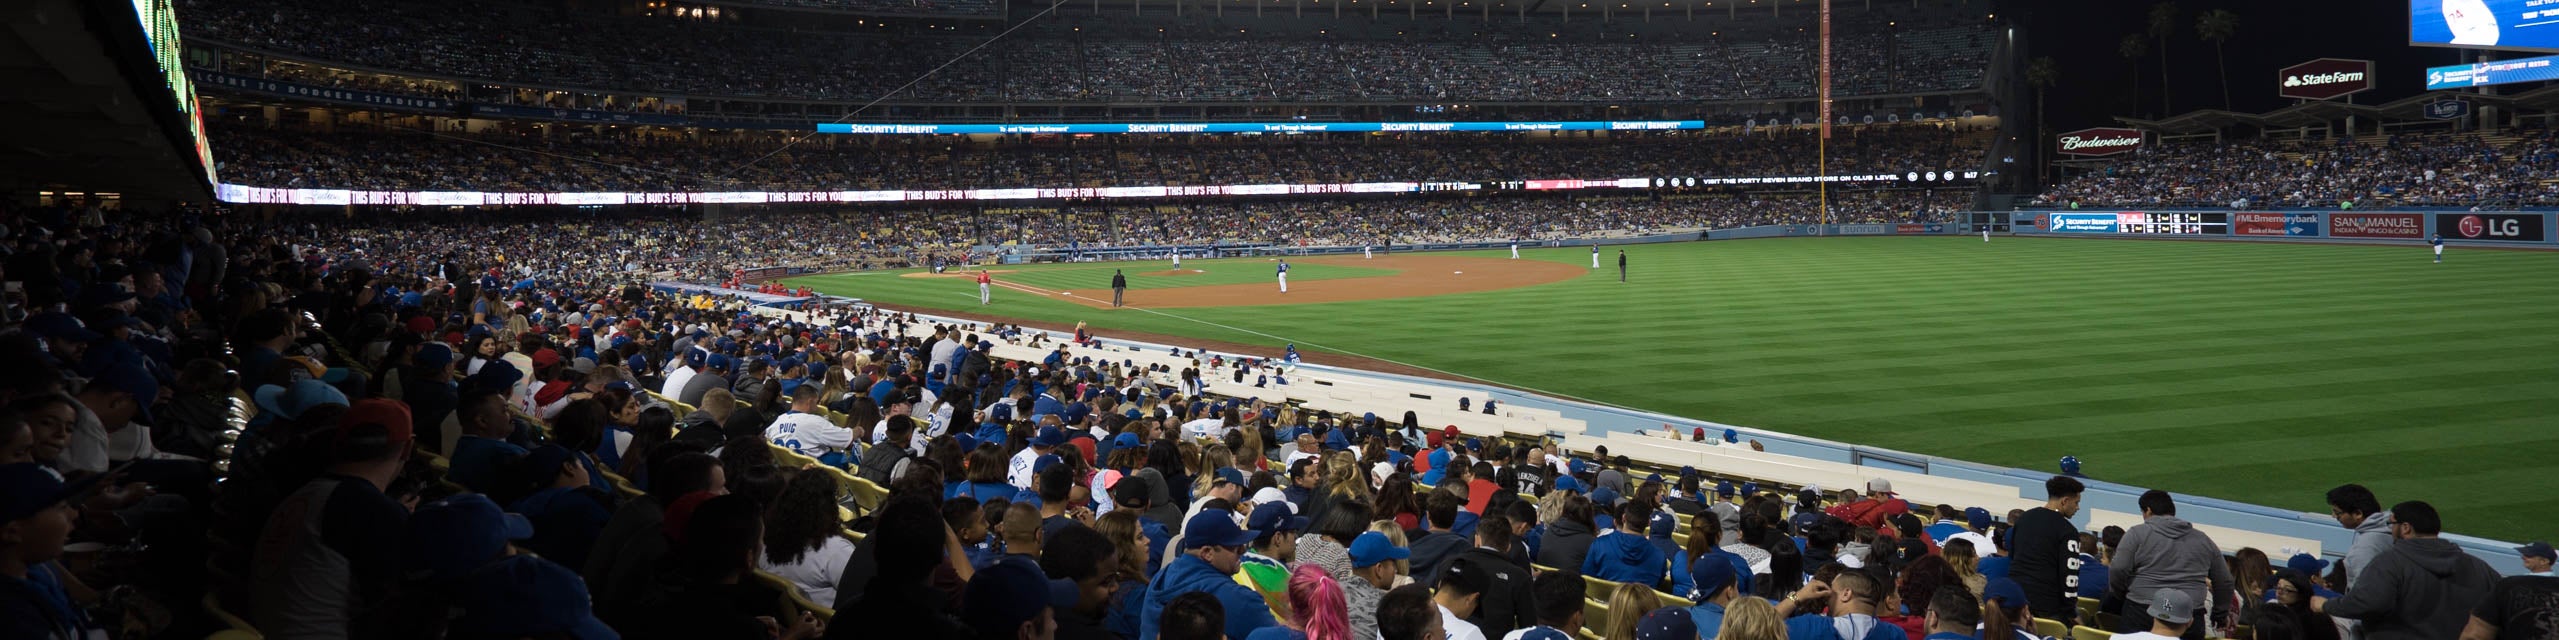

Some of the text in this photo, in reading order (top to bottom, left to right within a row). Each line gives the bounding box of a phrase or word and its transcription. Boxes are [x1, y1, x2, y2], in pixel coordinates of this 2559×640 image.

[196, 73, 437, 108] LCOME TO DODGER STADIUM
[851, 124, 895, 134] SECURITY
[1128, 124, 1168, 133] SECURITY
[1381, 122, 1418, 131] SECURITY
[1612, 121, 1648, 130] SECURITY
[2060, 135, 2140, 150] Budweiser
[1038, 187, 1055, 198] THIS
[1057, 187, 1078, 198] BUD'S
[1080, 187, 1094, 198] FOR
[1167, 185, 1183, 196] THIS
[1184, 185, 1205, 196] BUD'S
[1206, 185, 1220, 196] FOR
[1289, 183, 1305, 194] THIS
[1307, 183, 1327, 194] BUD'S
[1328, 183, 1341, 194] FOR
[352, 190, 368, 205] THIS
[369, 190, 390, 205] BUD'S
[391, 190, 406, 205] FOR
[484, 192, 503, 205] THIS
[504, 192, 528, 205] BUD'S
[529, 192, 545, 205] FOR
[626, 192, 645, 204] THIS
[646, 192, 670, 204] BUD'S
[671, 192, 687, 204] FOR
[768, 191, 786, 202] THIS
[787, 191, 810, 202] BUD'S
[812, 191, 827, 202] FOR
[906, 190, 923, 200] THIS
[924, 190, 946, 200] BUD'S
[948, 190, 963, 200] FOR
[2236, 214, 2318, 225] #MLBmemorybank
[2334, 217, 2418, 228] SAN MANUEL
[1844, 225, 1880, 233] sunrun
[2489, 219, 2520, 237] LG
[779, 423, 797, 434] PUIG
[1517, 472, 1544, 485] LENZUELA
